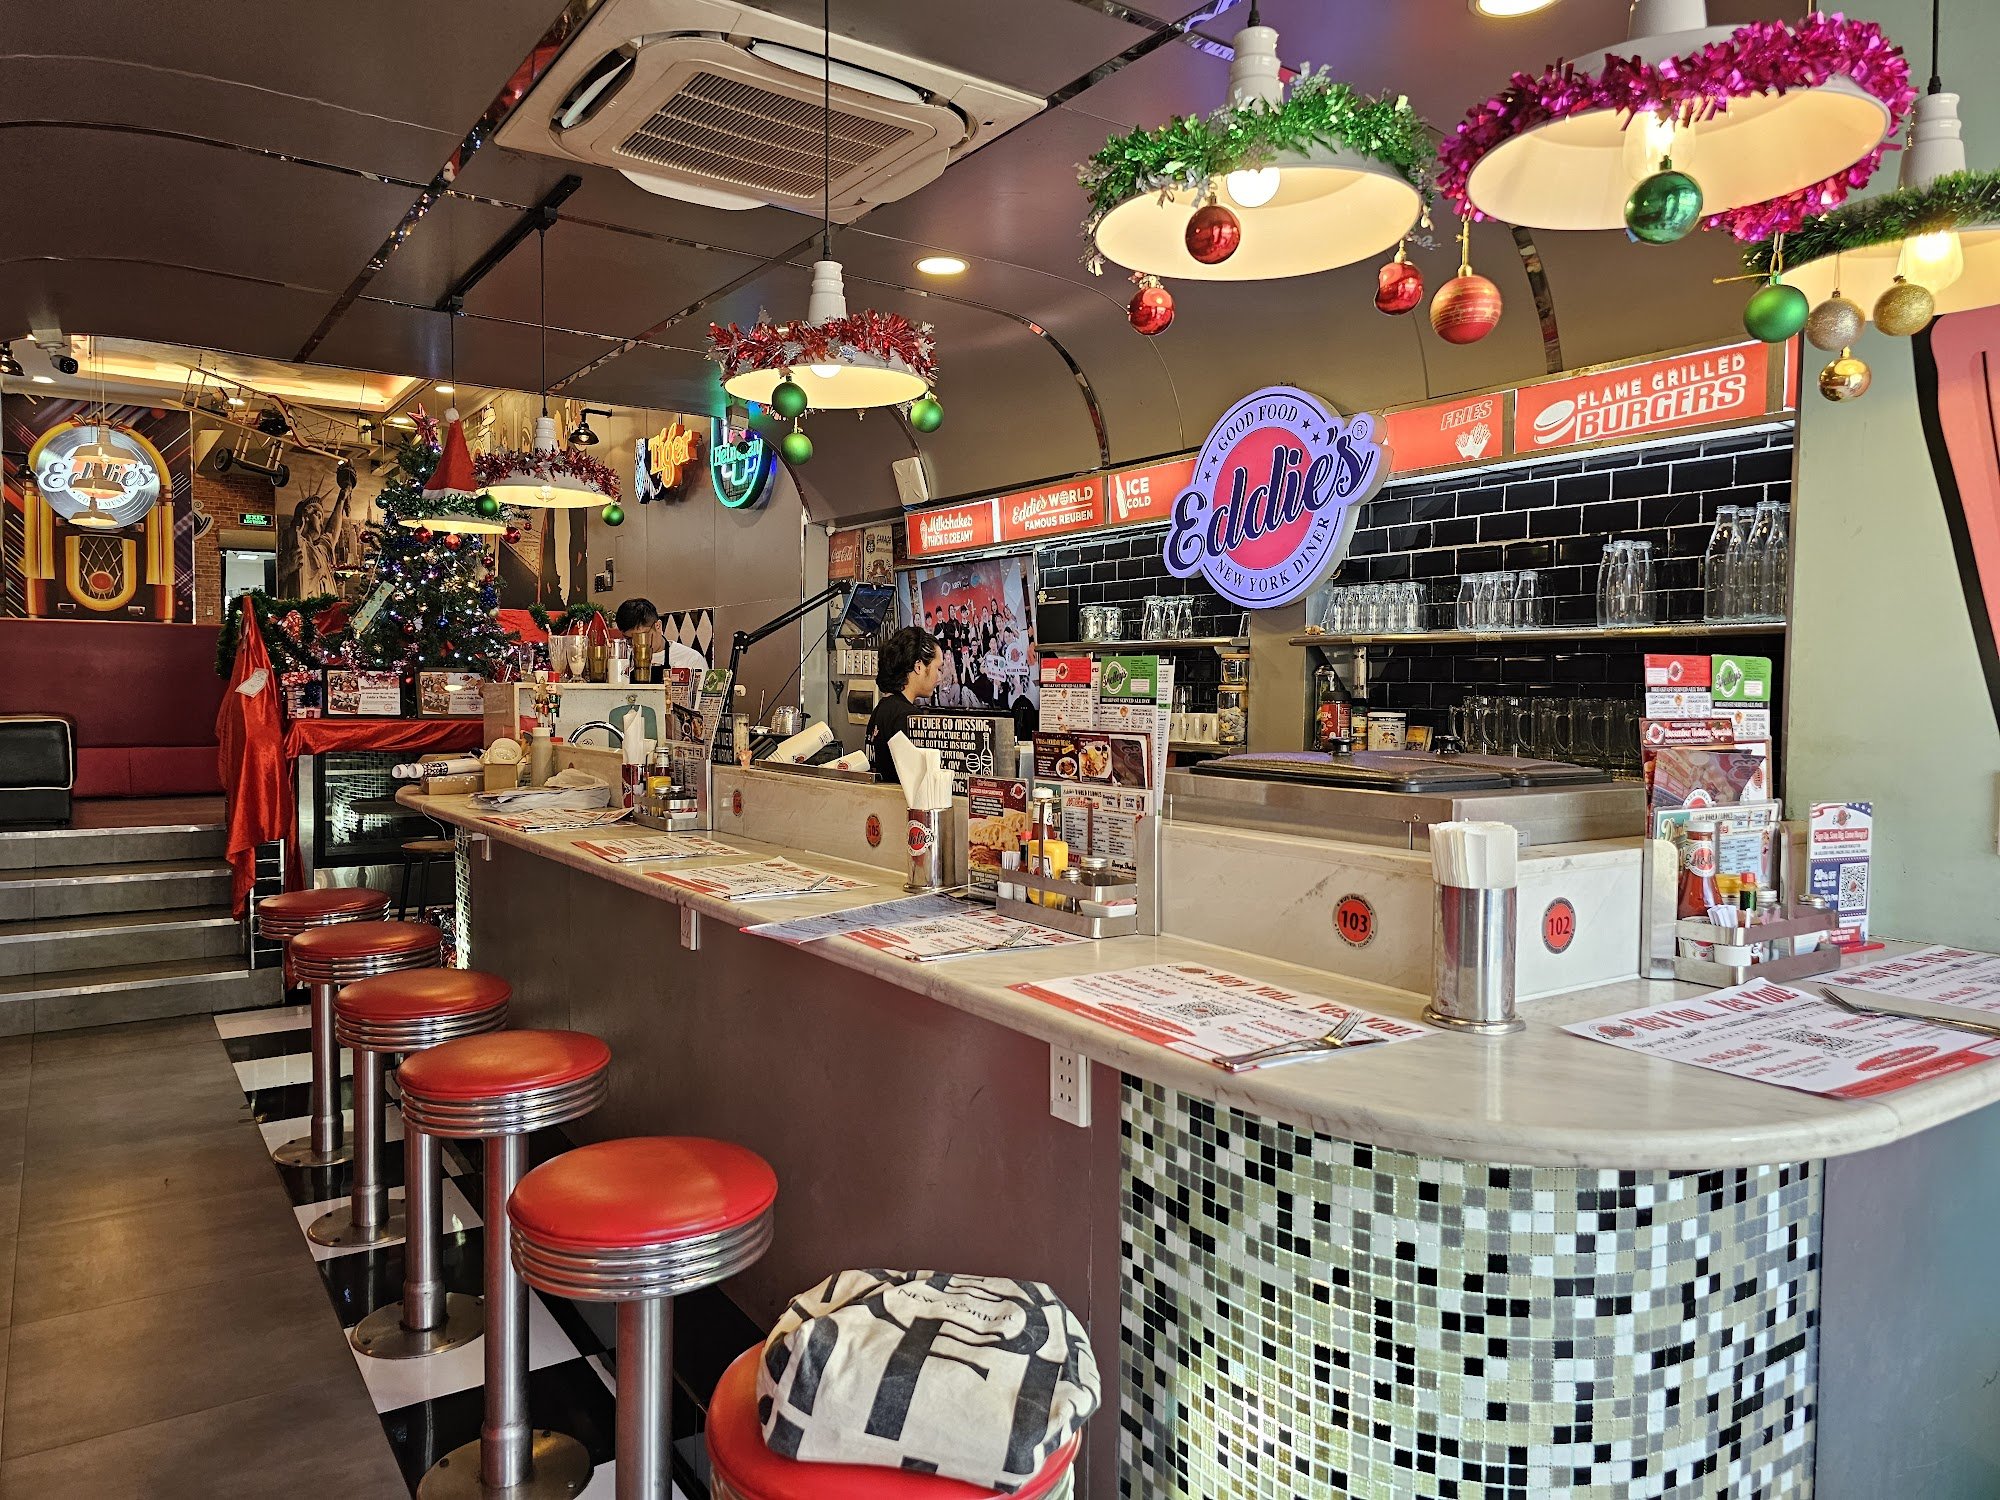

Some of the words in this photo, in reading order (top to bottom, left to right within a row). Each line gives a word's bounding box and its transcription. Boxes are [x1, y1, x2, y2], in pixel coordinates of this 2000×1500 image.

[1577, 377, 1643, 410] FLAME
[1651, 353, 1746, 391] GRILLED
[1440, 400, 1493, 431] FRIES
[1575, 373, 1747, 442] BURGERS
[1218, 411, 1254, 451] GOOD
[1258, 403, 1298, 423] FOOD
[648, 423, 694, 488] Tiger
[714, 439, 763, 467] Heineen
[1127, 477, 1150, 496] ICE
[1168, 425, 1375, 571] Eddie's
[1012, 495, 1048, 523] Eddie's
[1048, 486, 1094, 509] WORLD
[1127, 496, 1152, 509] COLD
[928, 512, 973, 535] Milkshakes
[1024, 516, 1058, 532] FAMOUS
[1059, 509, 1093, 526] REUBEN
[928, 534, 944, 547] THICK
[950, 530, 973, 544] CREAMY
[1215, 559, 1245, 588] NEW
[1249, 572, 1291, 593] YORK
[1293, 517, 1331, 574] DINER
[909, 717, 916, 729] IF
[922, 718, 941, 730] EVER
[942, 718, 953, 731] GO
[955, 719, 992, 734] MISSING,
[912, 731, 927, 739] WANT
[938, 731, 961, 740] PICTURE
[926, 741, 948, 750] BOTTLE
[949, 741, 976, 751] INSTEAD
[868, 825, 880, 837] 105
[908, 830, 934, 845] ddie's
[1341, 910, 1368, 933] 103
[1549, 915, 1570, 936] 102
[1205, 974, 1255, 987] Hey
[1307, 1003, 1352, 1019] Yes
[1360, 1017, 1425, 1037] You!
[1618, 1015, 1684, 1031] Hey
[1704, 999, 1762, 1012] Yes
[1736, 983, 1800, 1006] You!
[897, 1288, 936, 1304] NEW
